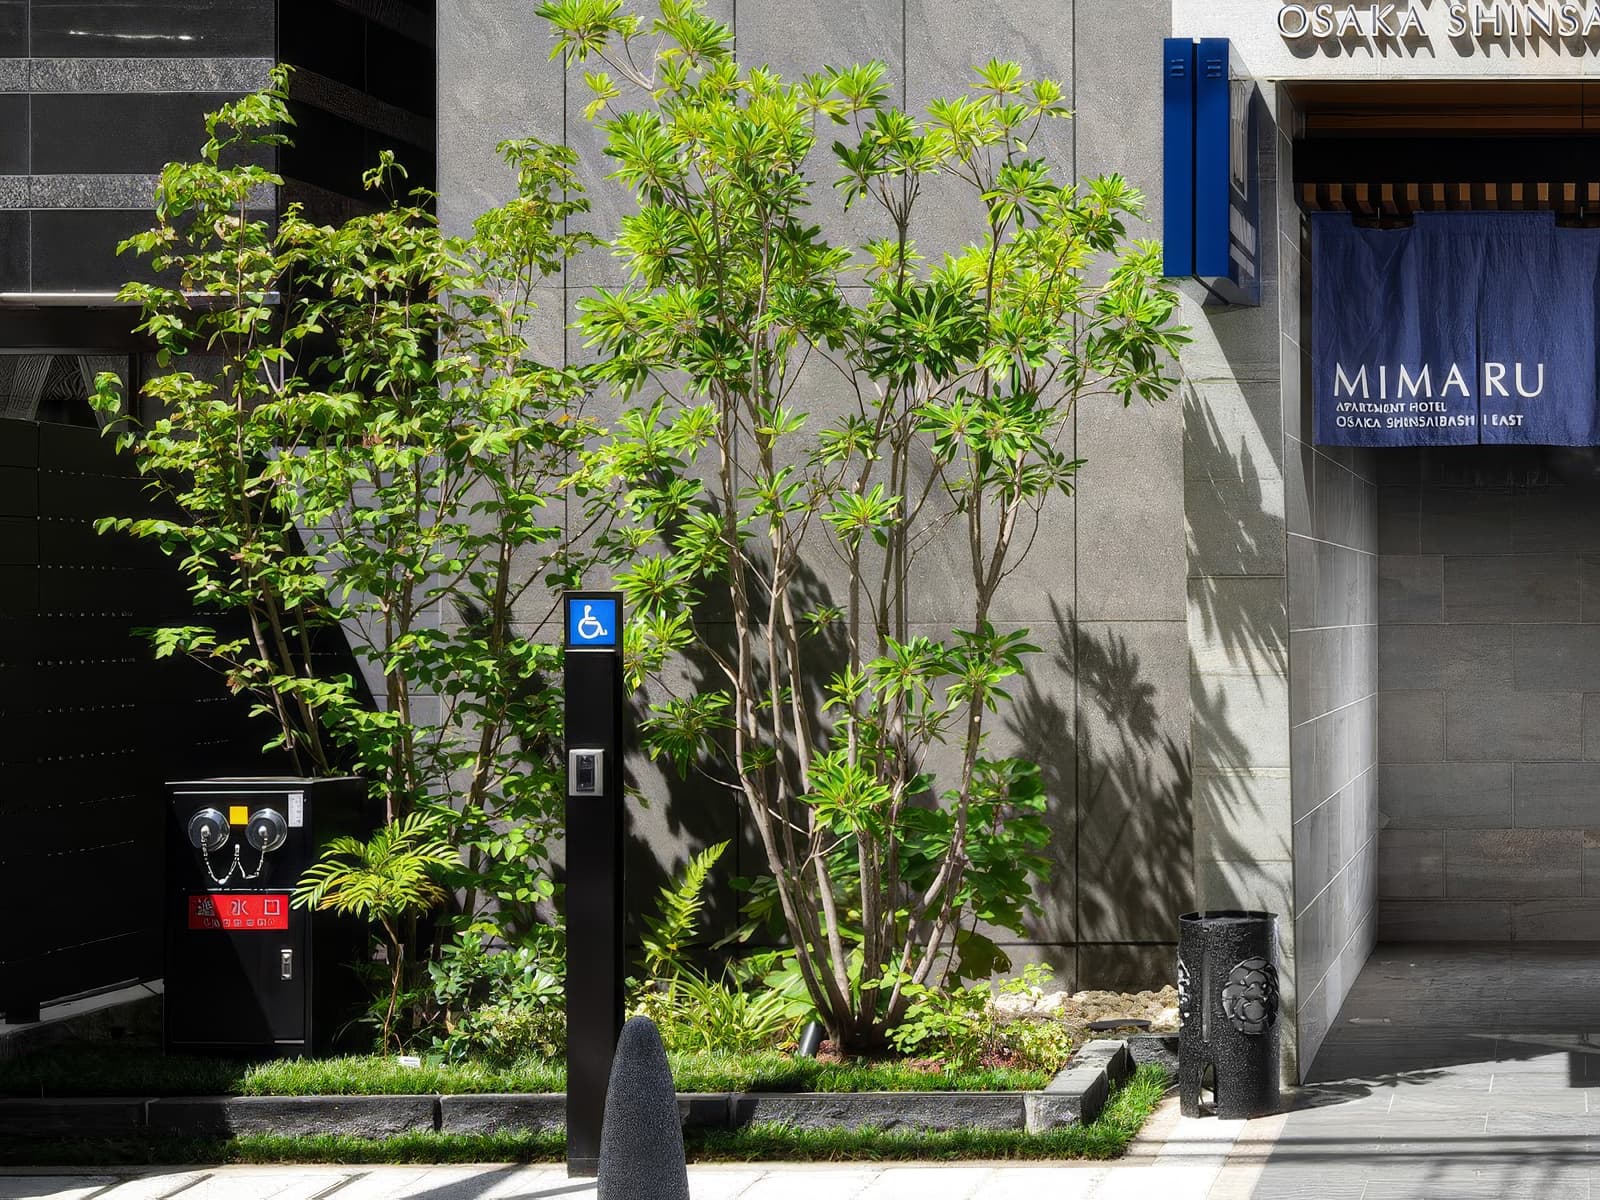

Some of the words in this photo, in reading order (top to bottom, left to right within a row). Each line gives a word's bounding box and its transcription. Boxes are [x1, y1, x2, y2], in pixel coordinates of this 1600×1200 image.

[1277, 3, 1428, 39] OSAKA
[1333, 362, 1545, 399] MIMARU
[1409, 402, 1448, 413] HOTEL
[1492, 415, 1524, 427] EAST
